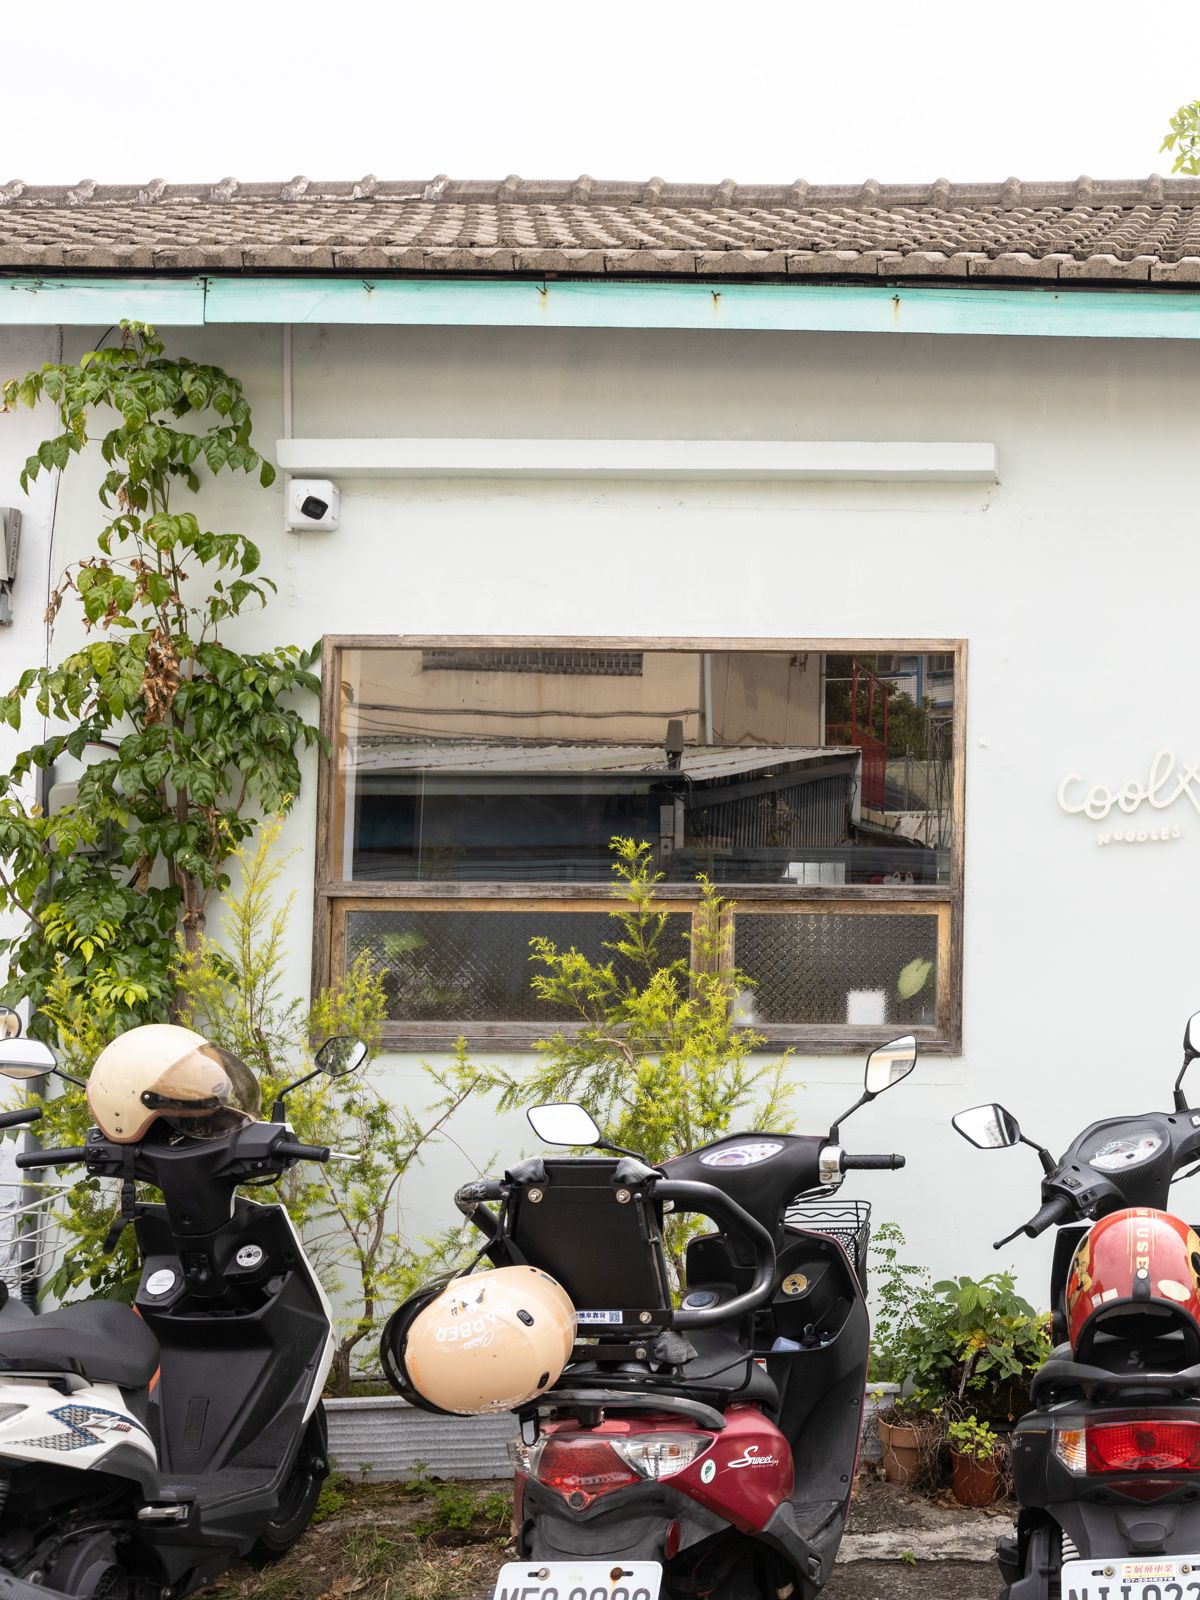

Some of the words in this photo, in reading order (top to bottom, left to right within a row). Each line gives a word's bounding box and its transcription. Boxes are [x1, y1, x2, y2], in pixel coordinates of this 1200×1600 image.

[1096, 823, 1182, 846] NOODLES
[436, 1302, 513, 1343] BARBER
[727, 1445, 774, 1469] Sweet
